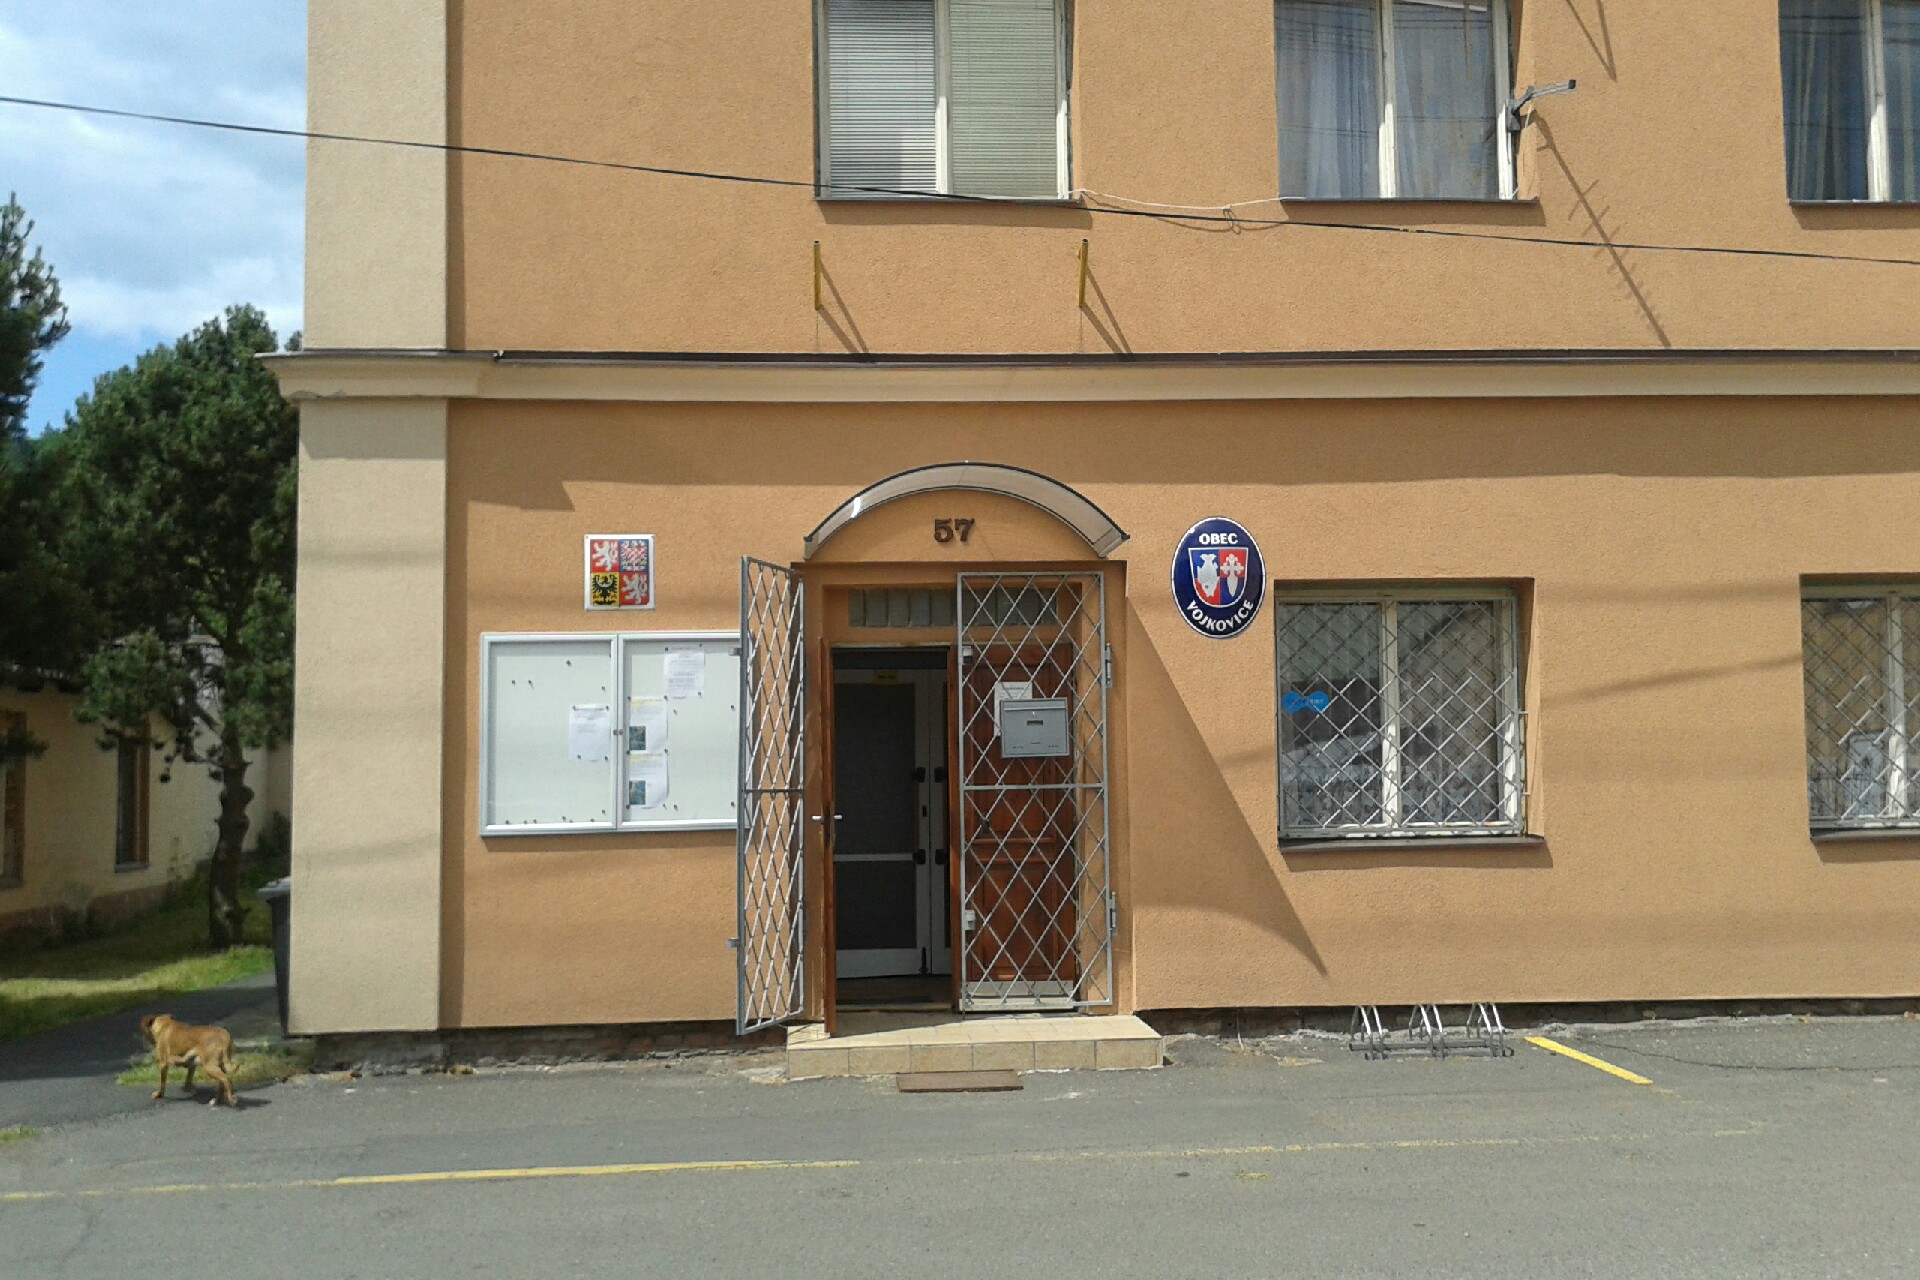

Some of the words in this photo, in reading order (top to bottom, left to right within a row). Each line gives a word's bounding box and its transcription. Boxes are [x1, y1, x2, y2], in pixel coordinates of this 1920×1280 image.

[934, 518, 975, 543] 57
[1198, 533, 1239, 545] OBEC
[1187, 600, 1254, 631] VOJKOVICE
